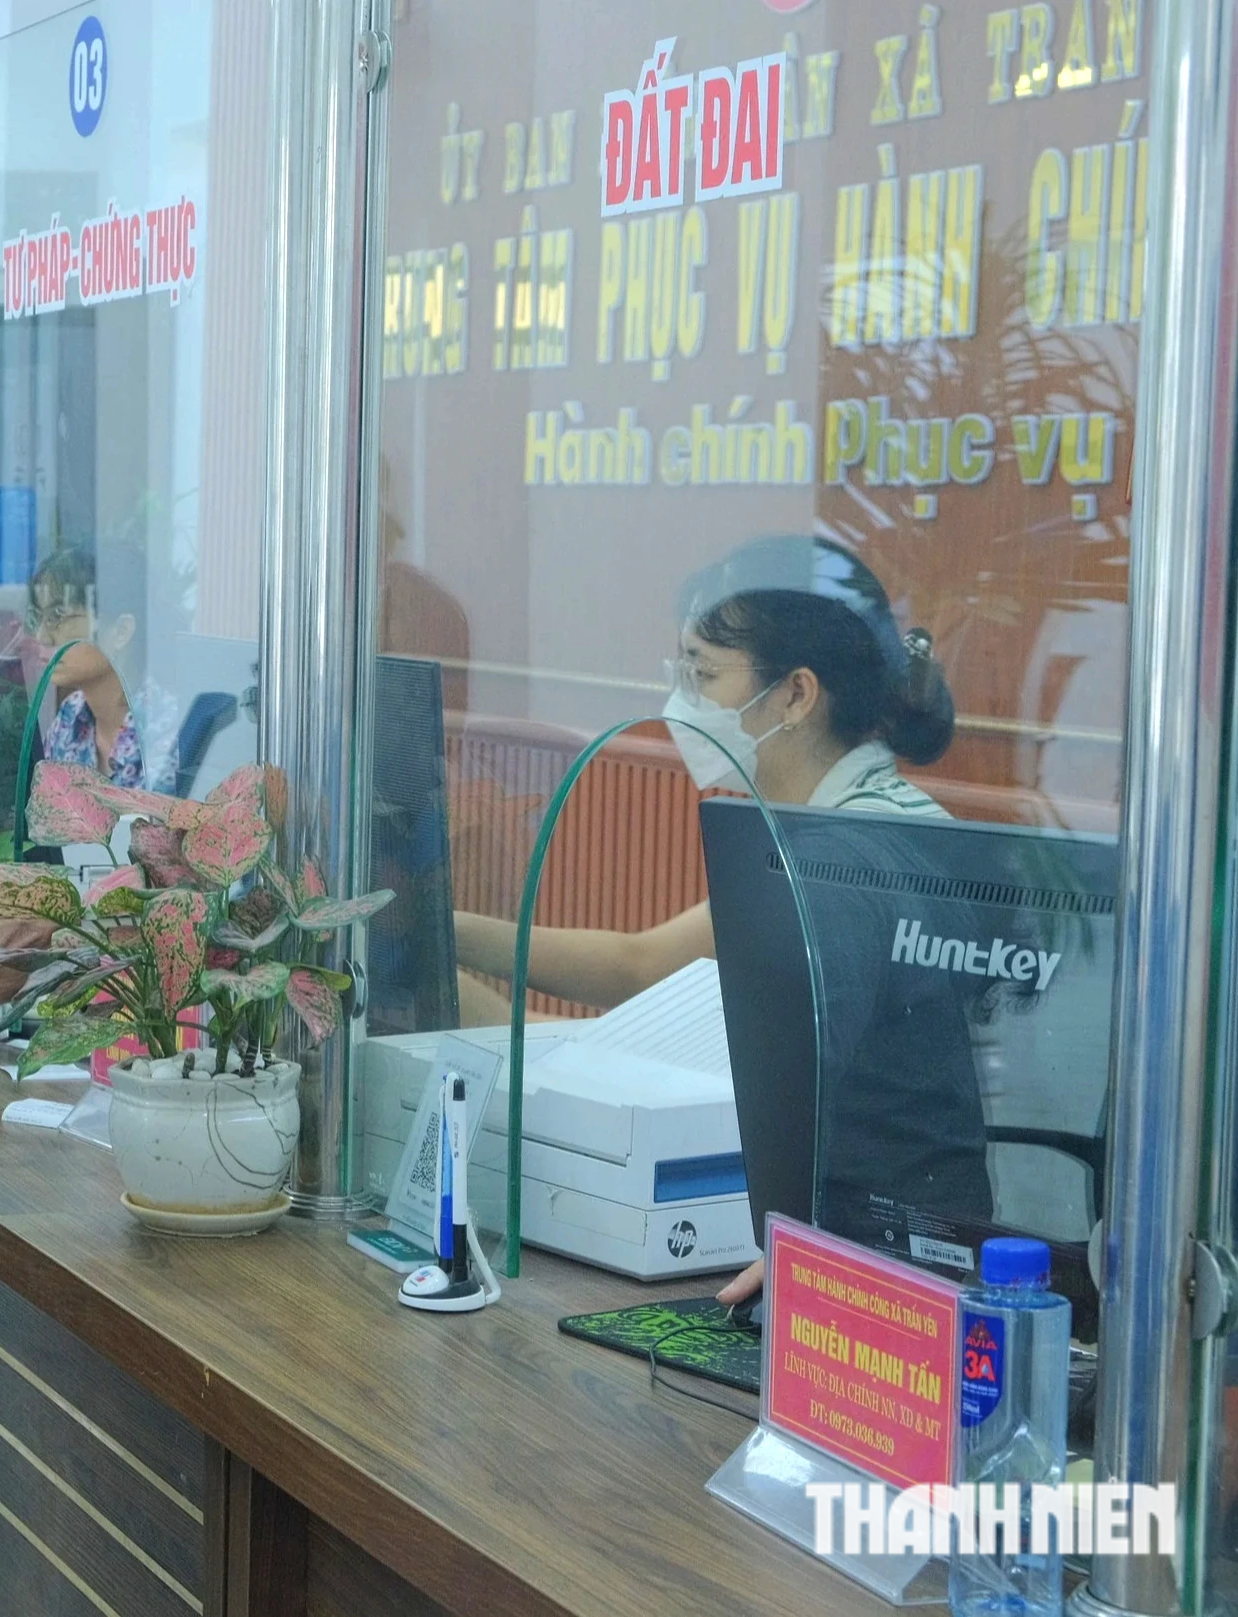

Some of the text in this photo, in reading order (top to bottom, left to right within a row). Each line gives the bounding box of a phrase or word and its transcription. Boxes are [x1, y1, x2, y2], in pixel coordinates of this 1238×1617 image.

[74, 37, 104, 113] 03
[503, 110, 576, 194] BAN
[605, 50, 781, 206] ĐẤT ĐAI
[147, 195, 196, 301] THỰC
[383, 243, 468, 380] RUNG
[493, 204, 573, 371] TÂM
[597, 207, 708, 381] PHỤC
[736, 192, 800, 375] VỤ
[831, 142, 983, 351] HÀNH
[524, 395, 1116, 521] Hành chính Phục vụ
[669, 1220, 696, 1258] hp
[791, 1262, 812, 1287] TRUNG
[812, 1269, 827, 1295] TÂM
[827, 1276, 846, 1302] HÀNH
[847, 1284, 869, 1310] CHÍNH
[869, 1292, 890, 1318] CÔNG
[922, 1312, 938, 1339] YÊN
[791, 1313, 942, 1405] NGUYỄN MẠNH TẤN
[964, 1350, 997, 1382] 3A
[810, 1399, 895, 1456] ĐT: 0973.036.939
[829, 1373, 845, 1399] ĐỊA
[847, 1382, 879, 1414] CHÍNH
[900, 1405, 913, 1429] XD
[914, 1412, 924, 1433] &
[925, 1416, 941, 1441] MT
